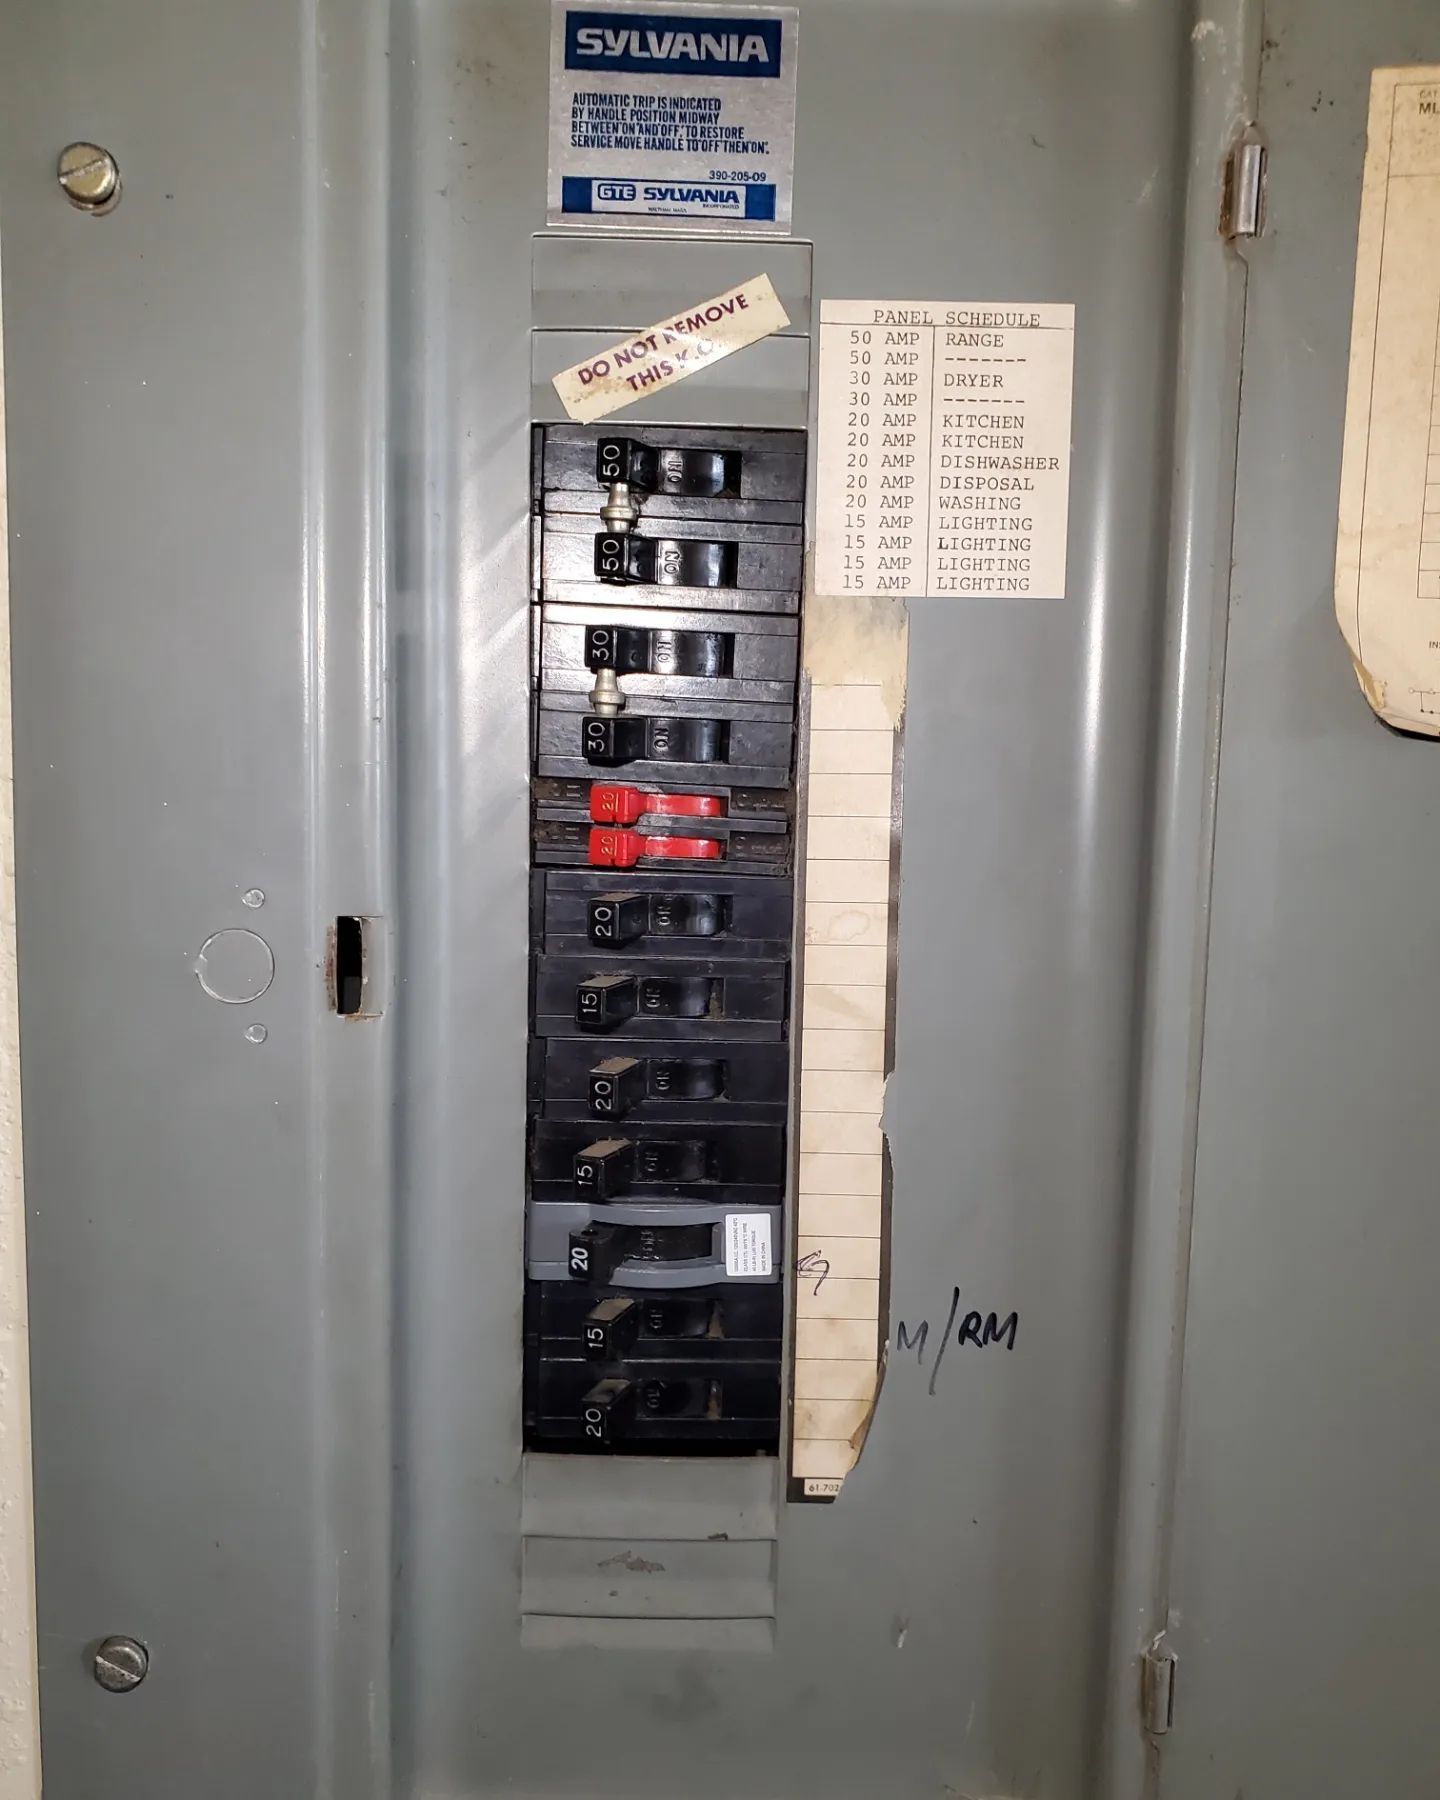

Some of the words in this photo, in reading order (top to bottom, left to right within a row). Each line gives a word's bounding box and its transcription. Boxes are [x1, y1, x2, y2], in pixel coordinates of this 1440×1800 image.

[576, 27, 769, 63] SYLVANIA
[572, 92, 630, 107] AUTOMATIC
[633, 95, 655, 108] TRIP
[658, 96, 667, 109] IS
[669, 97, 721, 111] INDICATED
[571, 107, 584, 119] BY
[588, 107, 626, 121] HANDLE
[630, 109, 676, 123] POSITION
[679, 112, 719, 125] MIDWAY
[571, 121, 618, 134] BETWEEN
[639, 123, 658, 136] AND
[686, 125, 698, 138] TO
[700, 126, 744, 140] RESTORE
[571, 135, 612, 148] SERVICE
[614, 135, 642, 150] MOVE
[644, 137, 684, 151] HANDLE
[686, 139, 698, 152] TO
[723, 140, 748, 154] THEN
[709, 170, 766, 182] 390-205-09
[599, 184, 635, 200] GTE
[643, 187, 740, 204] SYLVANIA
[872, 309, 934, 325] PANEL
[945, 311, 1041, 327] SCHEDULE
[577, 360, 611, 386] DO
[613, 334, 660, 369] NOT
[662, 294, 749, 344] REMOVE
[850, 331, 872, 345] 50
[884, 332, 920, 346] AMP
[945, 333, 1004, 348] RANGE
[849, 351, 871, 365] 50
[884, 352, 919, 366] AMP
[626, 360, 674, 391] THIS
[849, 371, 871, 385] 30
[883, 372, 918, 386] AMP
[943, 374, 1004, 388] DRYER
[849, 392, 870, 406] 30
[883, 393, 918, 407] AMP
[848, 412, 870, 427] 20
[882, 413, 917, 427] AMP
[942, 414, 1025, 429] KITCHEN
[847, 432, 869, 447] 20
[881, 433, 916, 447] AMP
[942, 434, 1024, 449] KITCHEN
[603, 445, 620, 477] 50
[847, 454, 868, 468] 20
[881, 454, 915, 468] AMP
[940, 456, 1060, 470] DISHWASHER
[846, 475, 868, 489] 20
[880, 475, 915, 489] AMP
[939, 476, 1034, 491] DISPOSAL
[845, 494, 867, 508] 20
[879, 495, 914, 509] AMP
[938, 496, 1021, 510] WASHING
[844, 514, 866, 528] 15
[878, 515, 913, 529] AMP
[938, 516, 1033, 531] LIGHTING
[844, 535, 865, 549] 15
[877, 536, 913, 550] AMP
[937, 536, 1031, 551] LIGHTING
[603, 539, 619, 571] 50
[664, 550, 681, 574] ON
[843, 555, 865, 569] 15
[877, 556, 912, 570] AMP
[936, 557, 1031, 571] LIGHTING
[842, 575, 864, 589] 15
[876, 576, 911, 590] AMP
[936, 576, 1030, 591] LIGHTING
[592, 630, 609, 661] 30
[588, 722, 605, 752] 30
[653, 728, 669, 751] ON
[601, 836, 614, 856] 20
[595, 906, 612, 937] 20
[581, 993, 597, 1013] 15
[595, 1080, 612, 1111] 20
[577, 1165, 593, 1185] 15
[571, 1247, 589, 1271] 20
[588, 1328, 604, 1348] 15
[585, 1408, 602, 1437] 20
